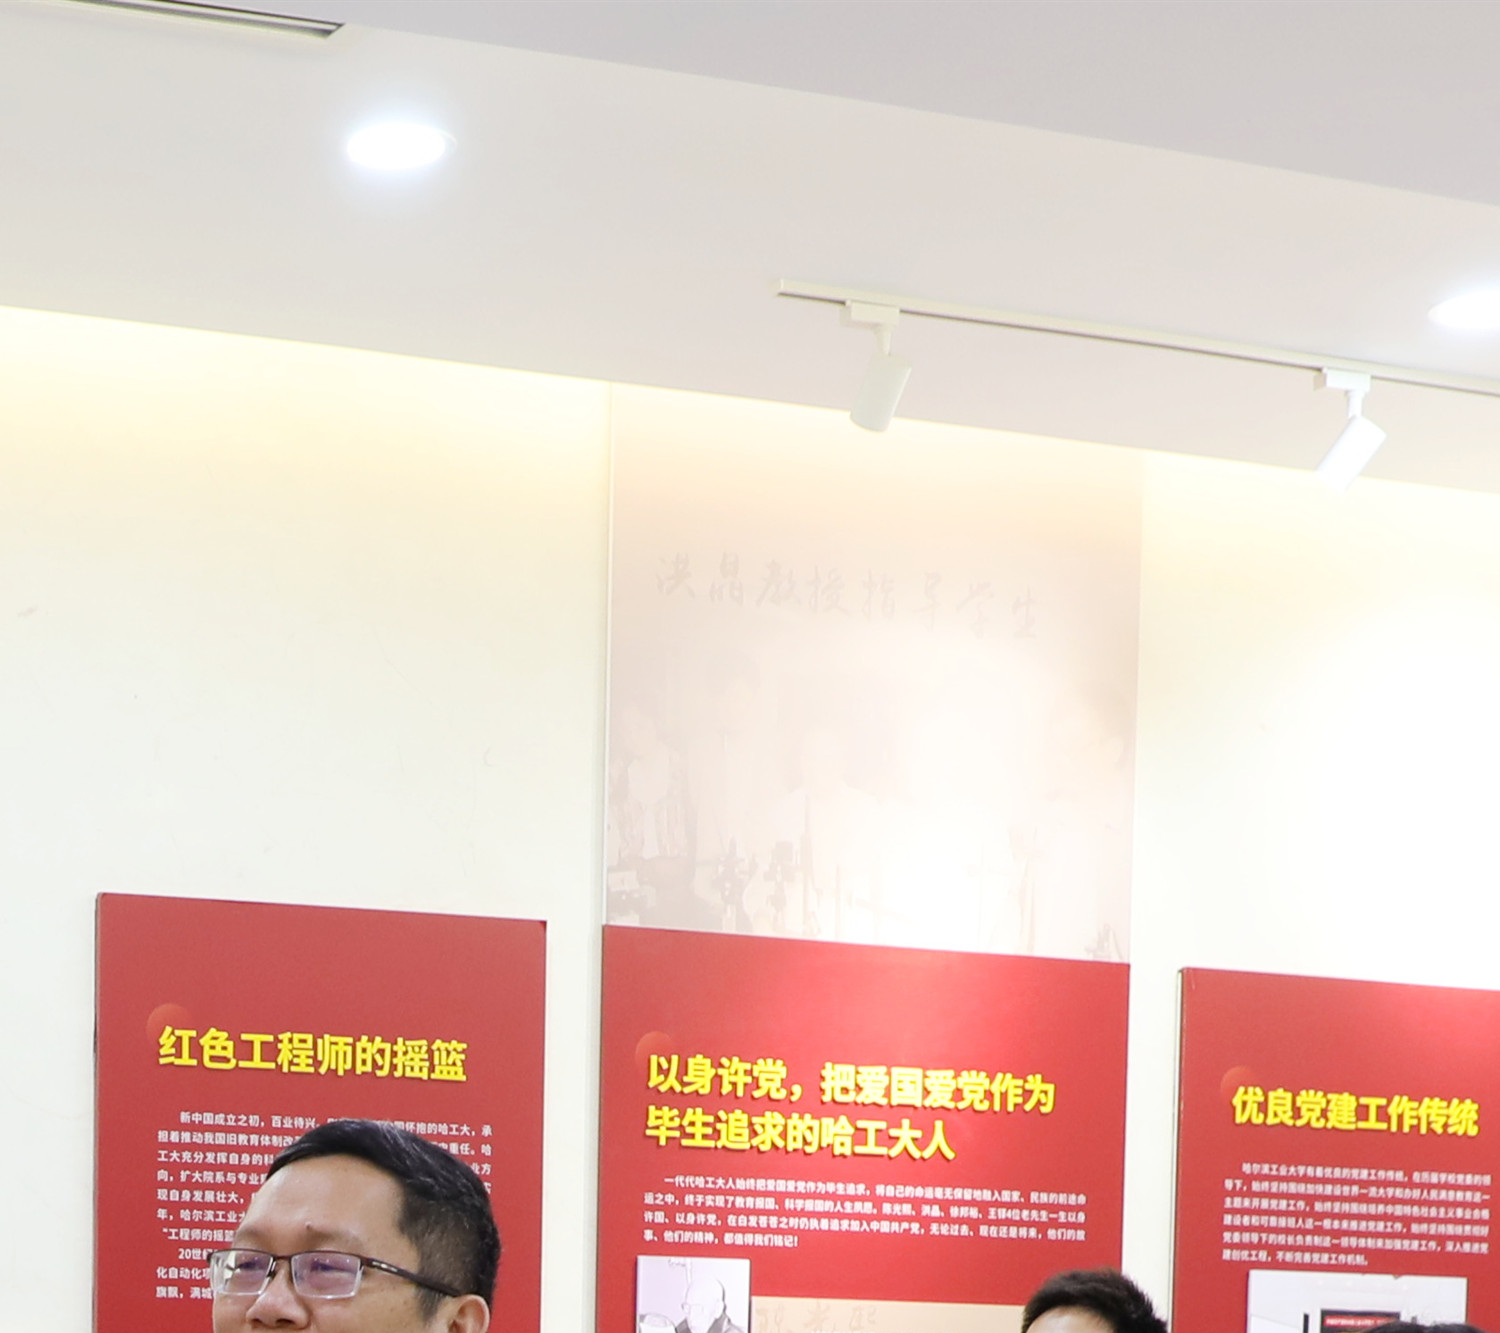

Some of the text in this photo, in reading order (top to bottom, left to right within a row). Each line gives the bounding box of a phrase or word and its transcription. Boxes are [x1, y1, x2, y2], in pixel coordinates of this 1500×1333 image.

[158, 1025, 467, 1082] 红色工程师的摇篮
[647, 1053, 1057, 1114] 以身许党，把爱国爱党作为
[1232, 1086, 1480, 1137] 优良党建工作传统
[645, 1106, 956, 1161] 毕生追求的哈工大人
